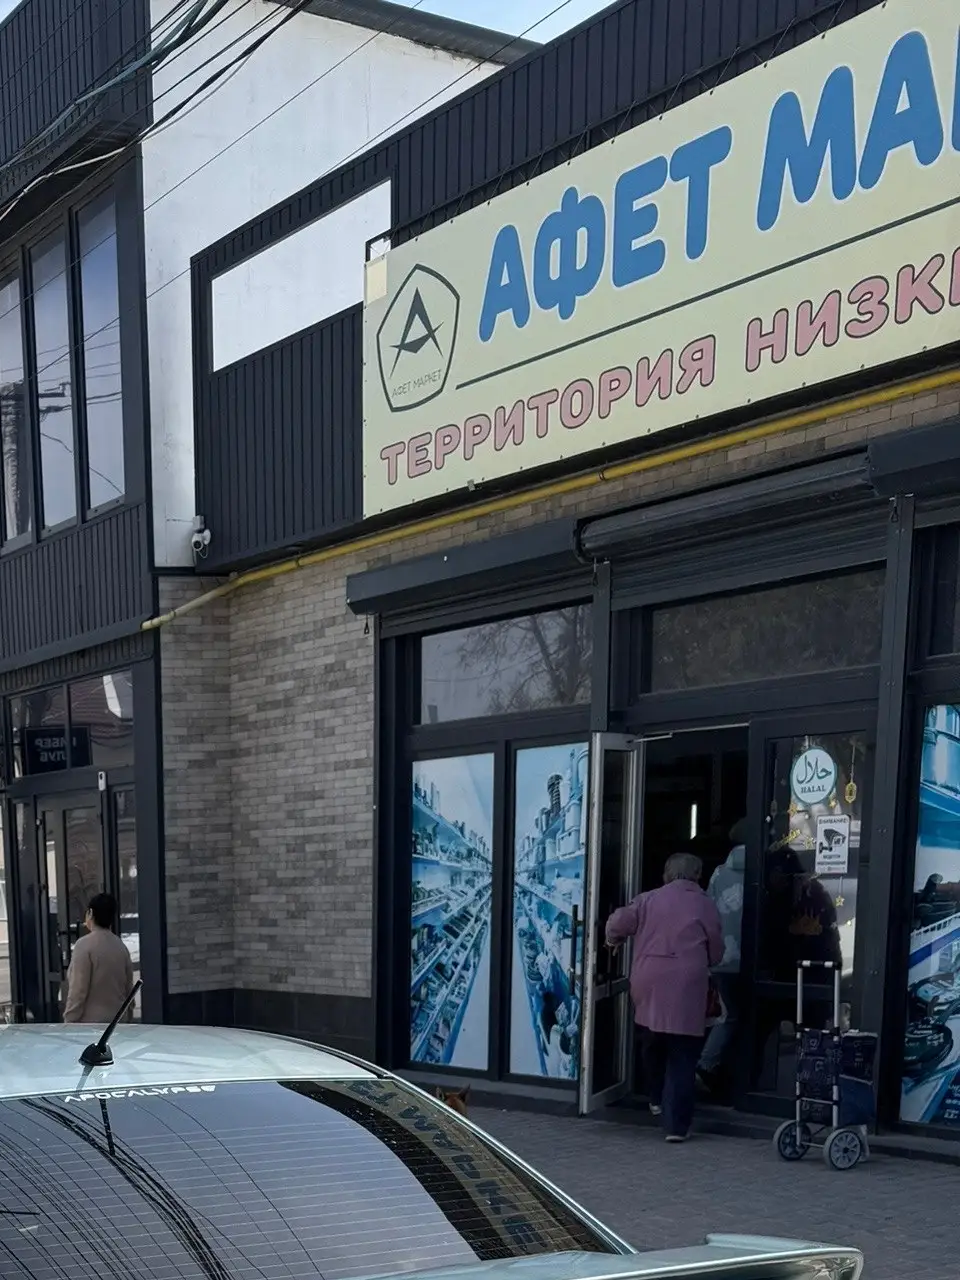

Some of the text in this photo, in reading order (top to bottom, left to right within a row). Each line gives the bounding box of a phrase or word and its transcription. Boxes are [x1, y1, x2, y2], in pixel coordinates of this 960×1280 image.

[478, 24, 960, 343] АФЕТ МА
[380, 246, 960, 485] ТЕРРИТОРИЯ НИЗК
[392, 369, 441, 398] АФЕТ МАРКЕТ
[797, 755, 832, 784] حلال
[801, 784, 826, 794] HALAL
[64, 1085, 216, 1103] APOCALYPSE
